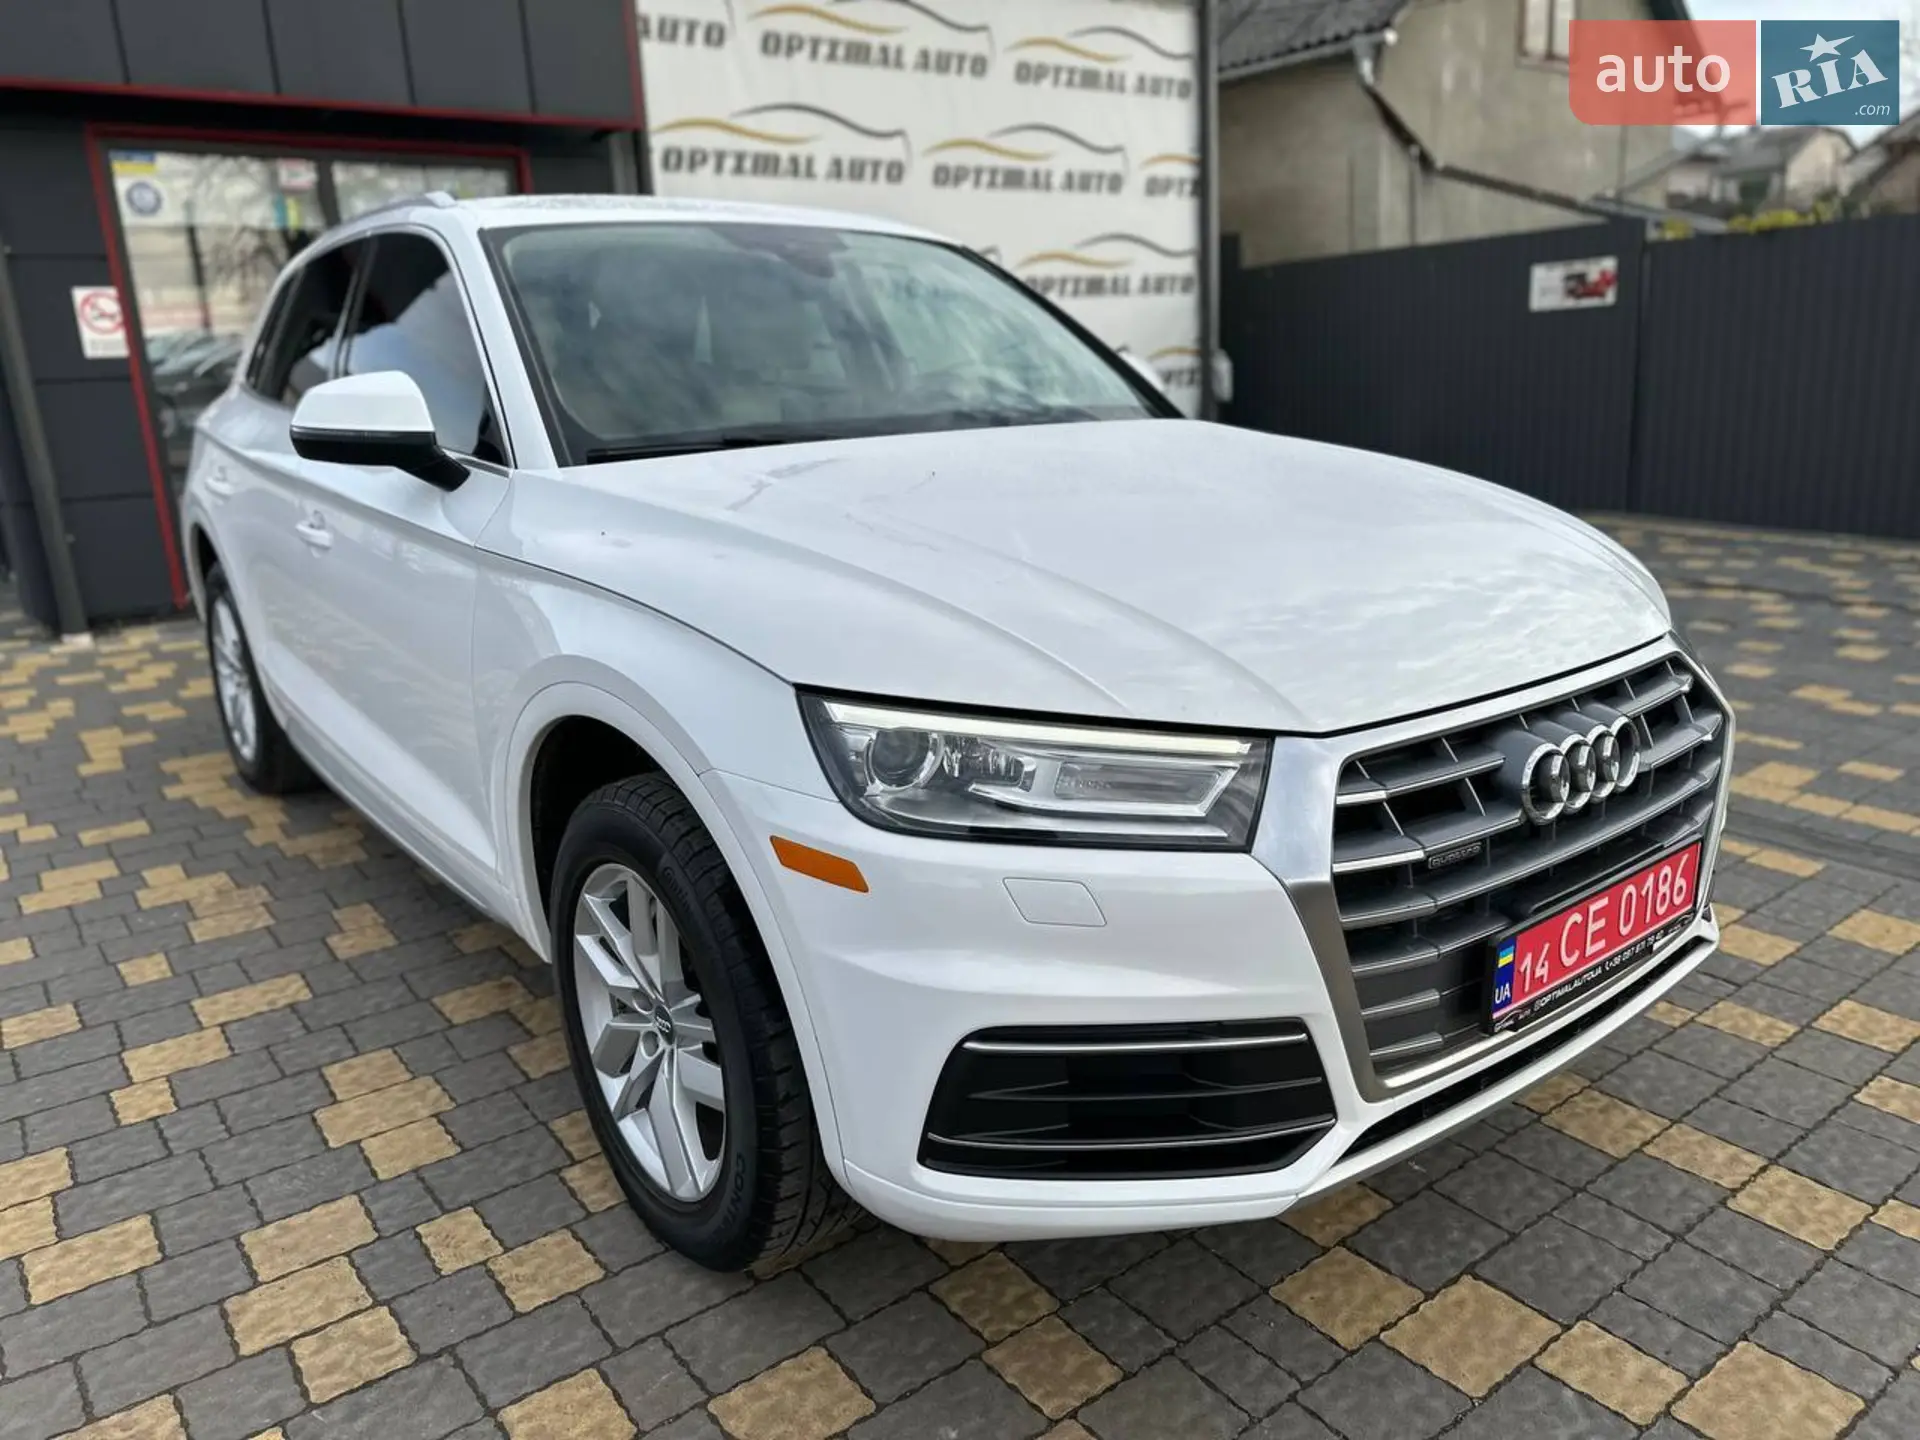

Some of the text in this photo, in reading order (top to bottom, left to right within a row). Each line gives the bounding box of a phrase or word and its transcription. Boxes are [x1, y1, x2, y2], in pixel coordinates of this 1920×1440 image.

[760, 29, 988, 78] OPTIMAL AUTO
[1014, 60, 1192, 100] OPTIMAL AUTO
[660, 145, 906, 185] OPTIMAL AUTO
[931, 164, 1124, 195] OPTIMAL AUTO
[1138, 272, 1195, 296] AUTO
[1520, 853, 1689, 992] 14 CE 0186
[1494, 982, 1511, 1004] UA
